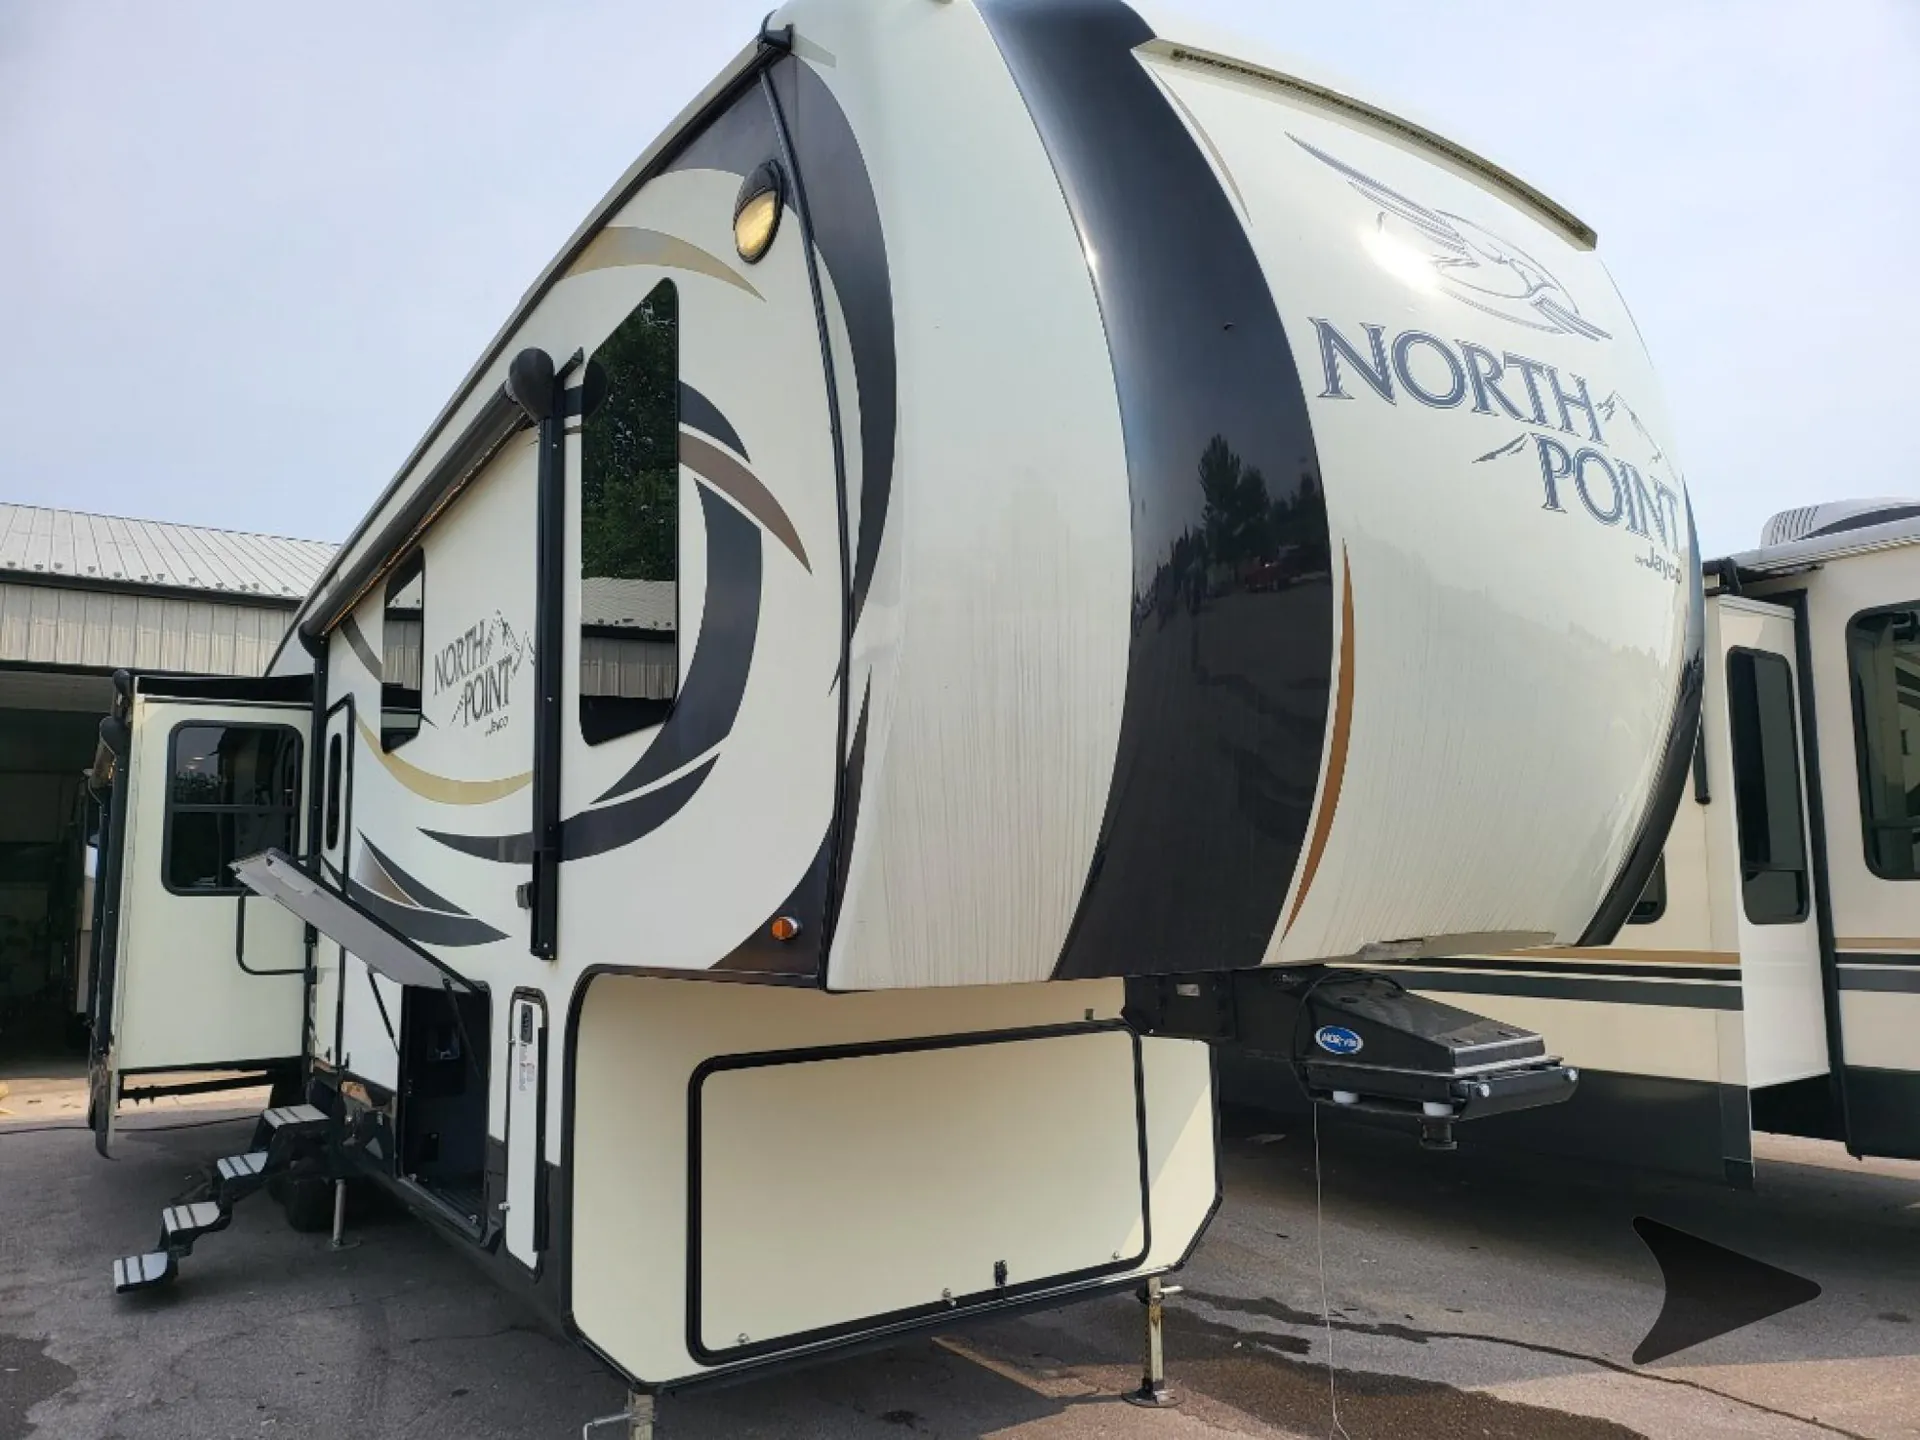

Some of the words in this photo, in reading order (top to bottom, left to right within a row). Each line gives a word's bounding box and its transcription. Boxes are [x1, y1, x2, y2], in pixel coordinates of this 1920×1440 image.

[1307, 316, 1608, 447] NORTH
[1529, 432, 1683, 560] POINT
[1646, 545, 1683, 585] Jayco
[433, 619, 485, 697] NORTH
[463, 653, 513, 728] POINT
